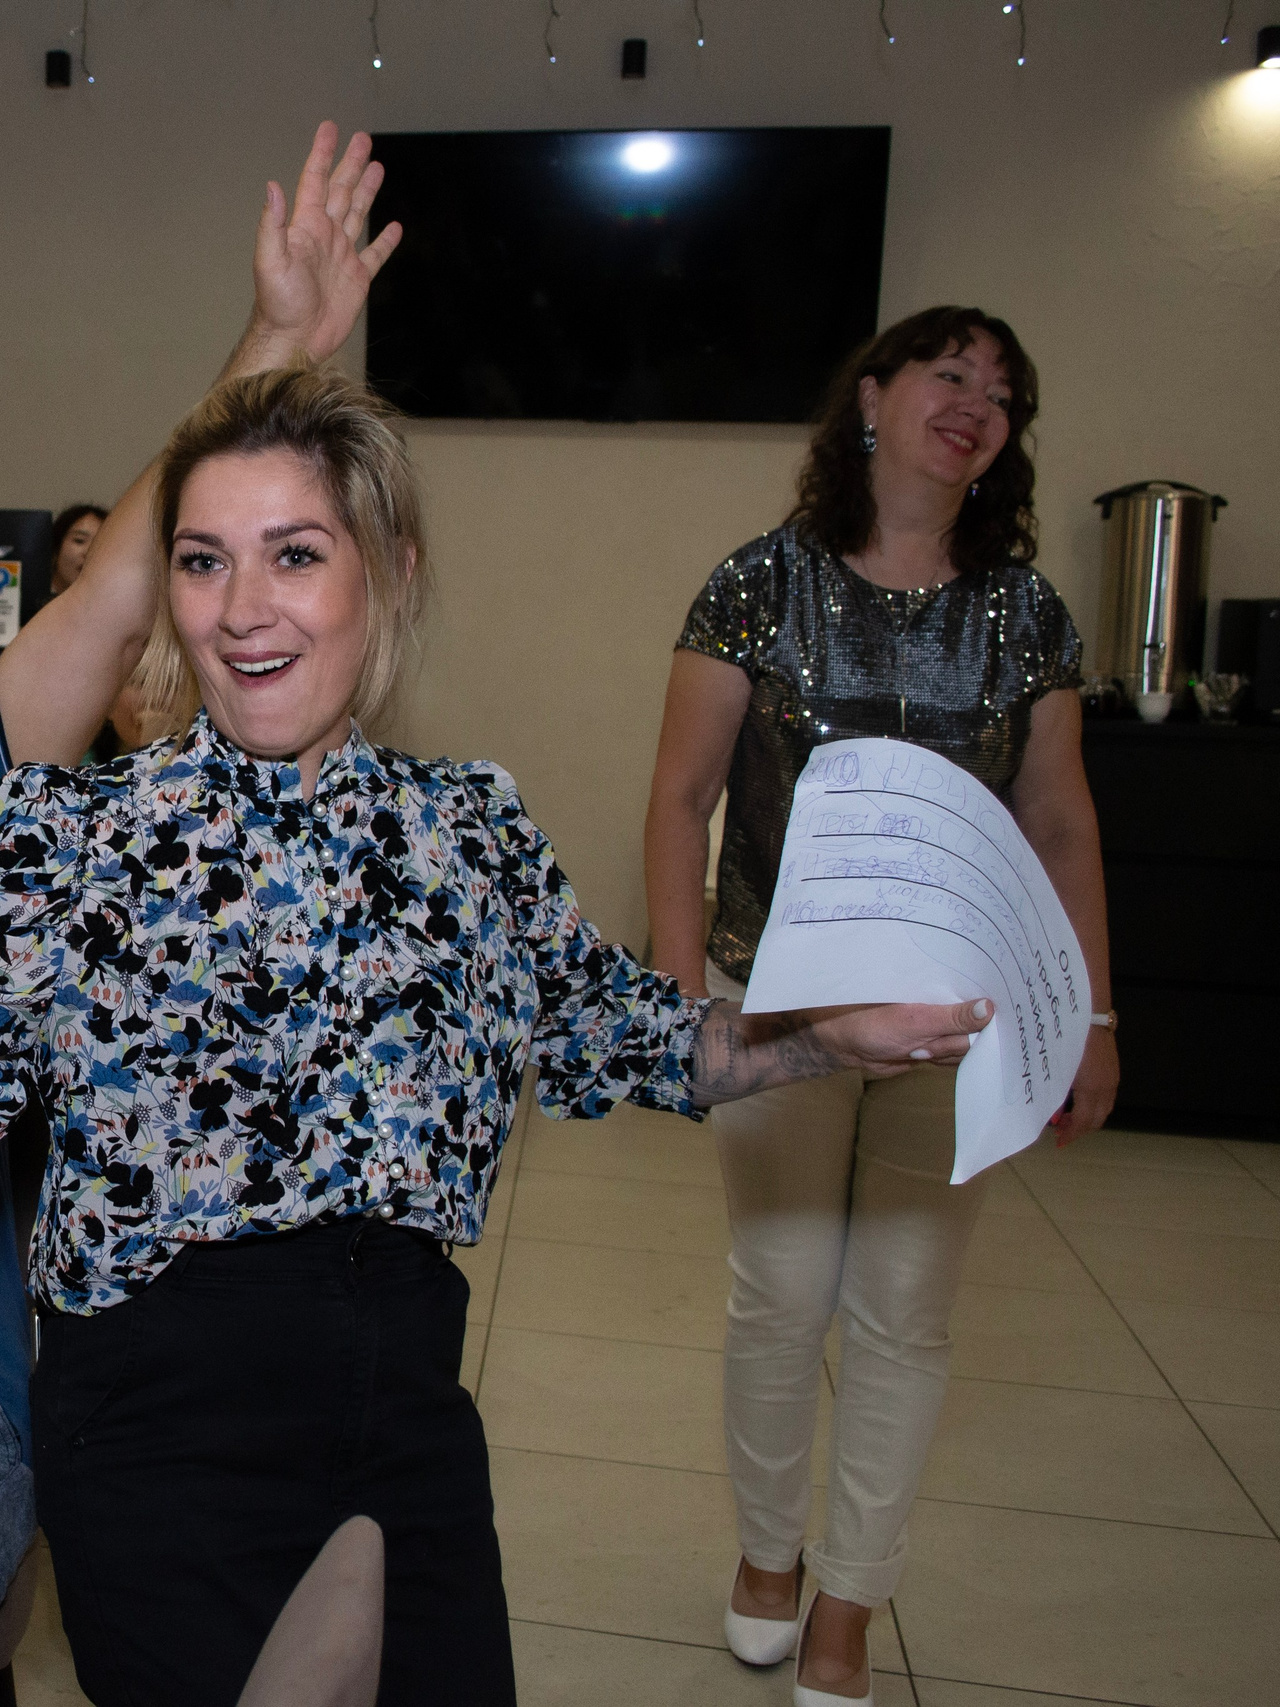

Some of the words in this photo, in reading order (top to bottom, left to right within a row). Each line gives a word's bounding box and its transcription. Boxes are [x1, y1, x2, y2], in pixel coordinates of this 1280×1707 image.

[1025, 976, 1051, 1082] кайфует
[1034, 949, 1063, 1039] пробег
[1058, 949, 1078, 1014] Олег
[1015, 1003, 1034, 1105] смакует
